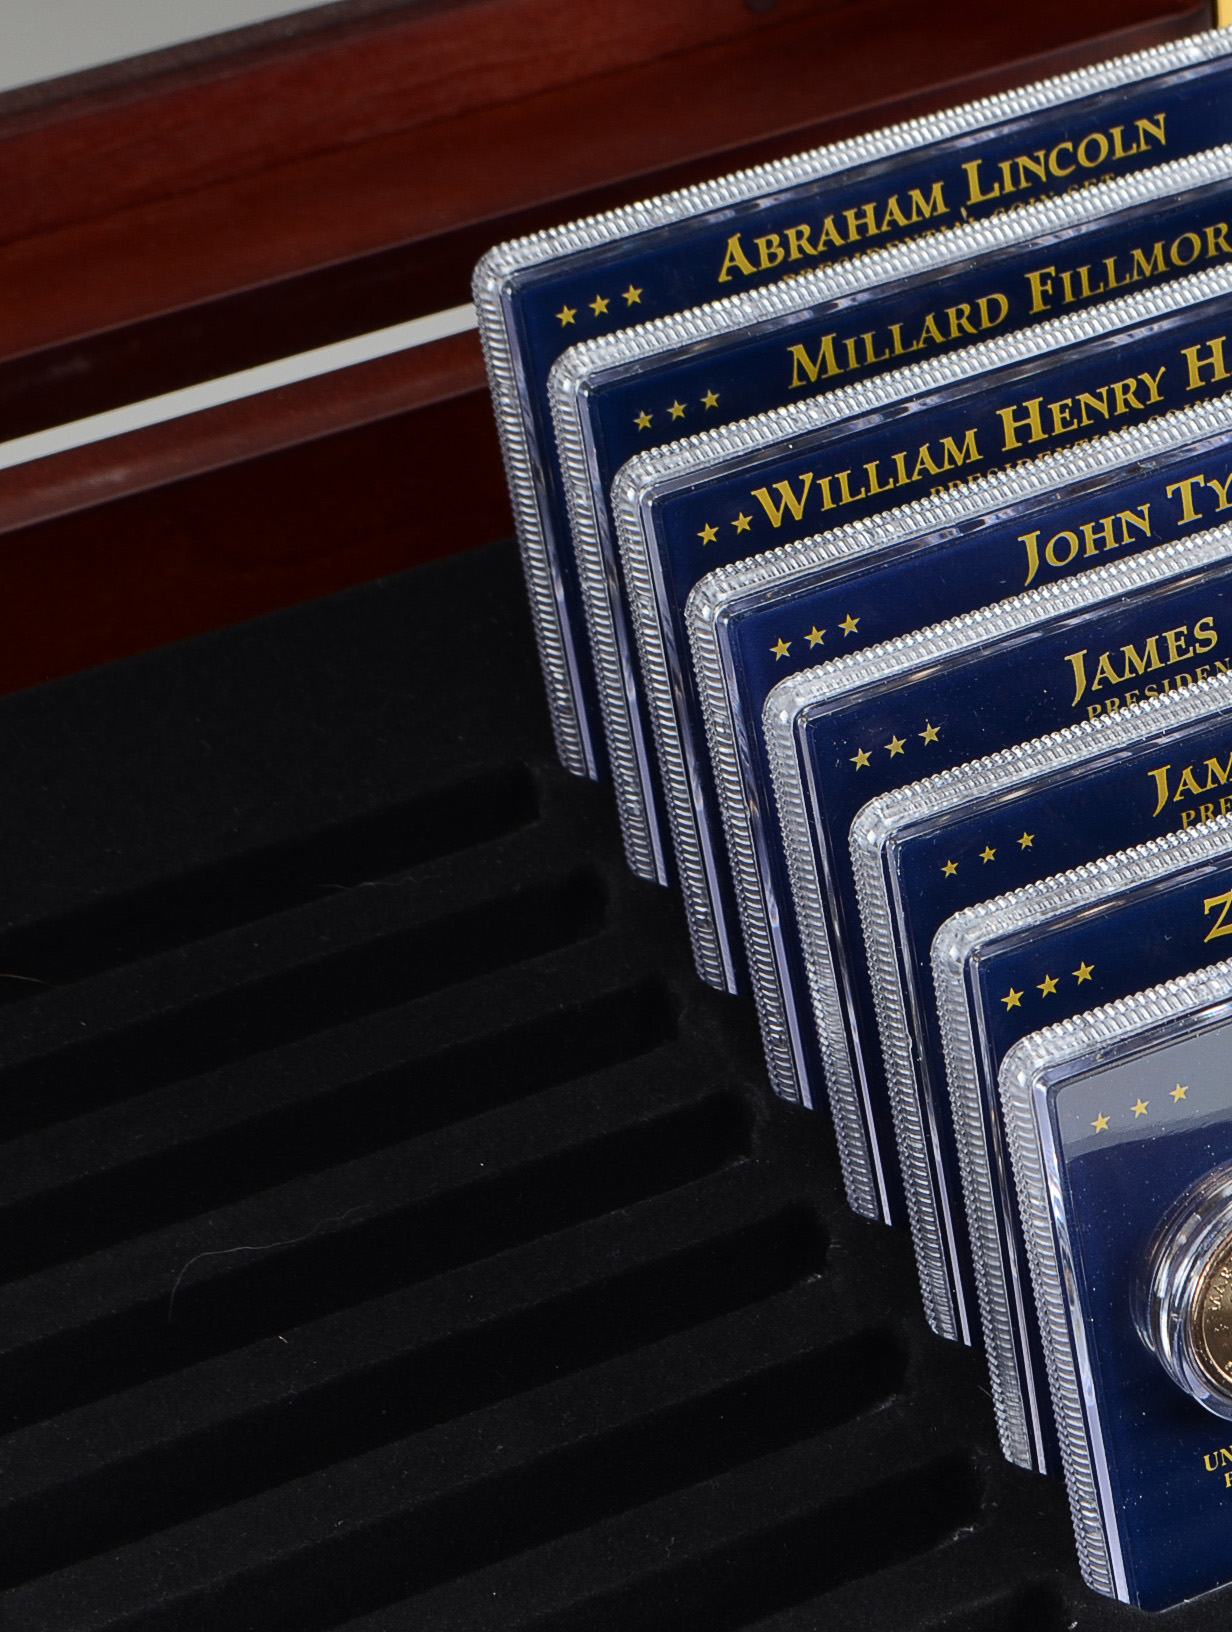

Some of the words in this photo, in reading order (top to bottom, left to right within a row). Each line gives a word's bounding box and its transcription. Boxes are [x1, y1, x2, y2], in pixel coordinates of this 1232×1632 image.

[717, 180, 949, 283] ABRAHAM
[962, 113, 1167, 204] LINCOLN
[788, 293, 1009, 389] MILLARD
[751, 429, 980, 529] WILLIAM
[996, 366, 1166, 452] HENRY
[1018, 504, 1154, 587] JOHN
[1065, 616, 1218, 707] JAMES
